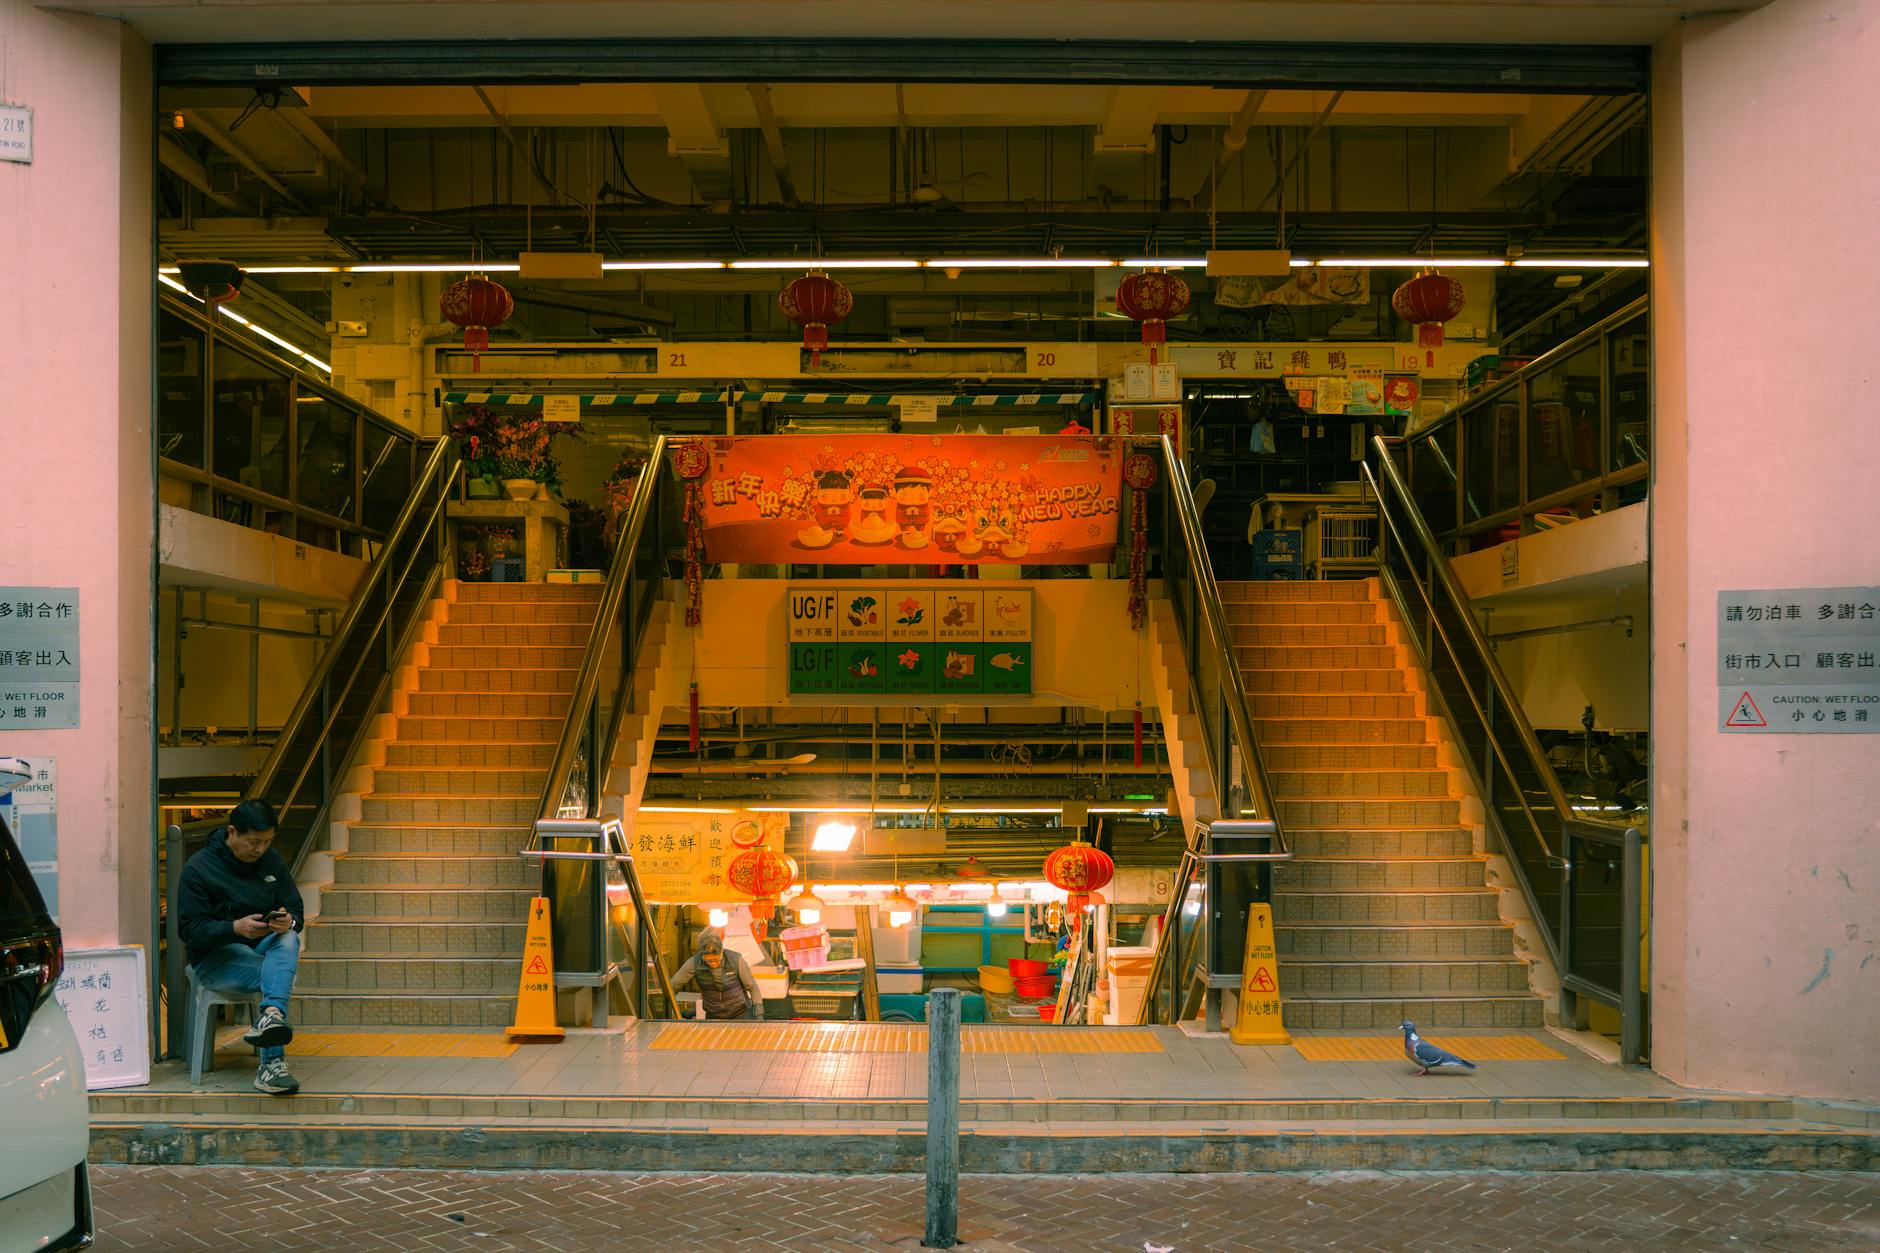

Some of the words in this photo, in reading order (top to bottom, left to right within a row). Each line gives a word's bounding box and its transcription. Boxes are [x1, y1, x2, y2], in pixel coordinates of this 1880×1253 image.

[12, 141, 26, 150] ROAD
[670, 353, 687, 367] 21
[1037, 353, 1055, 366] 20
[1217, 350, 1346, 370] 寶記雞鴨
[1401, 354, 1418, 369] 19
[711, 471, 807, 517] 新年快樂
[1036, 483, 1101, 505] HAPPY
[1021, 504, 1062, 522] NEW
[1066, 497, 1118, 518] YEAR
[0, 602, 72, 618] 多謝合作
[793, 596, 834, 619] UG/F
[1726, 605, 1802, 621] 請勿泊車
[1817, 603, 1880, 620] 多謝合
[795, 628, 832, 637] 地下高層
[0, 650, 71, 666] 顧客出入
[794, 649, 833, 672] LG/F
[1725, 653, 1801, 669] 街市入口
[1816, 652, 1880, 668] 顧客出
[1850, 695, 1880, 703] FLOO
[1792, 709, 1868, 722] 小心地滑
[630, 834, 696, 853] 發海鮮
[709, 818, 723, 887] 歡迎預訂
[1157, 882, 1167, 895] 9
[524, 983, 549, 992] 小心地滑
[1246, 1000, 1279, 1016] 小心地滑
